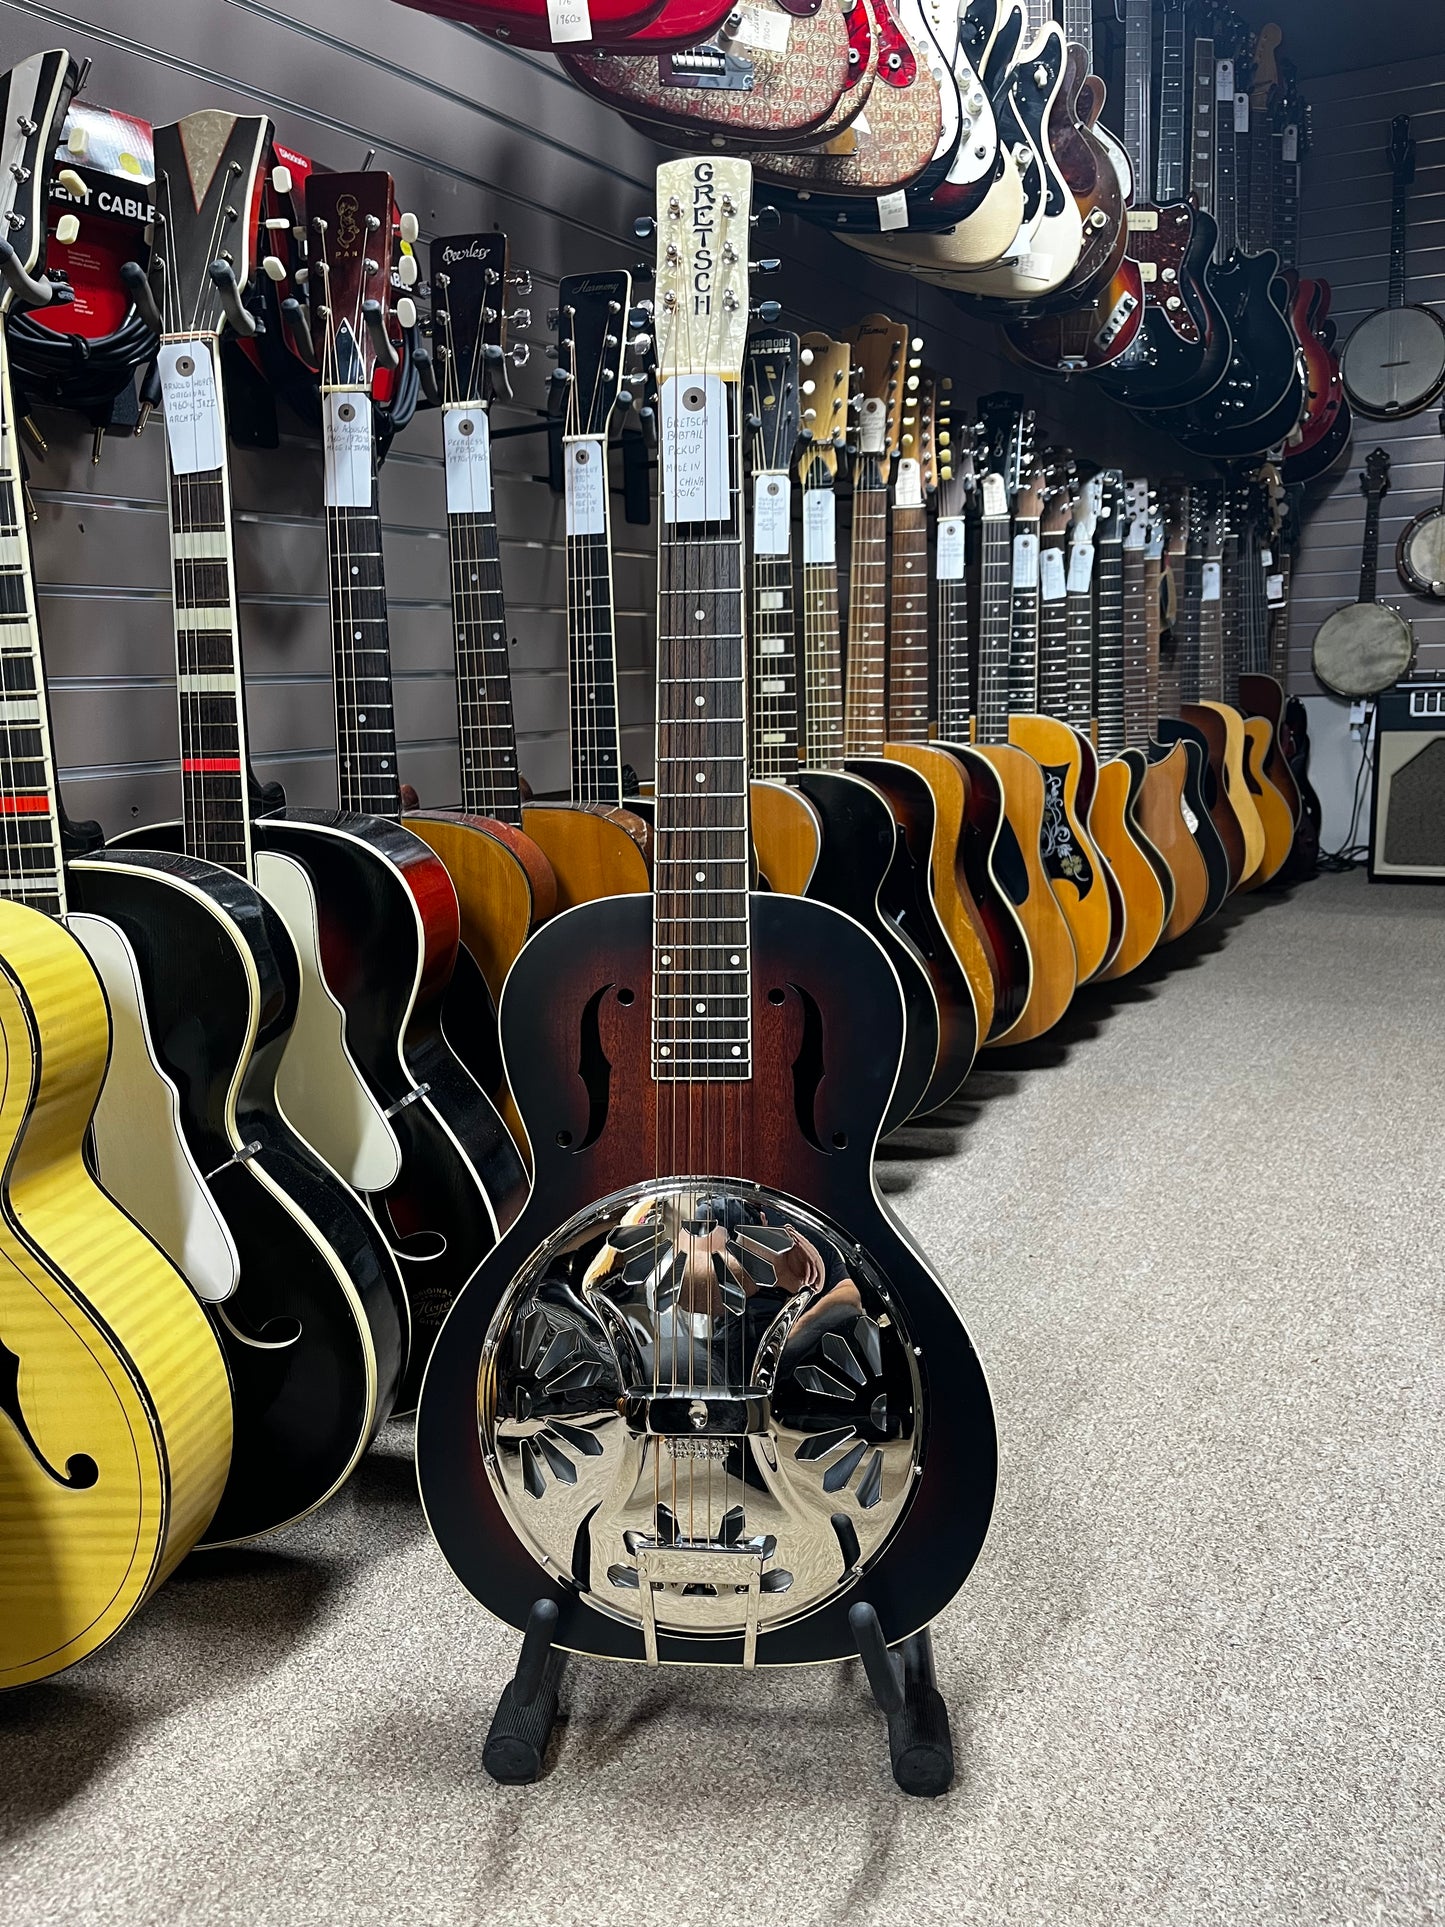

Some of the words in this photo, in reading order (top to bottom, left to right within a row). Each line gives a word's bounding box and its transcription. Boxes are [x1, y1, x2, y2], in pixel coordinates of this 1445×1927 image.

[556, 14, 582, 25] 1960s
[98, 191, 155, 223] CABLE
[693, 163, 716, 315] GRETSCH
[335, 250, 358, 259] PAN
[442, 240, 491, 265] Peerless
[571, 280, 620, 295] Harmony
[749, 338, 791, 349] HARMONY
[750, 347, 791, 355] MASTER
[667, 429, 704, 441] BBTAIL
[668, 444, 701, 456] PCKUP
[666, 462, 688, 473] MDE
[690, 460, 701, 472] IN
[679, 476, 705, 487] CHINA
[419, 1318, 445, 1326] GITA
